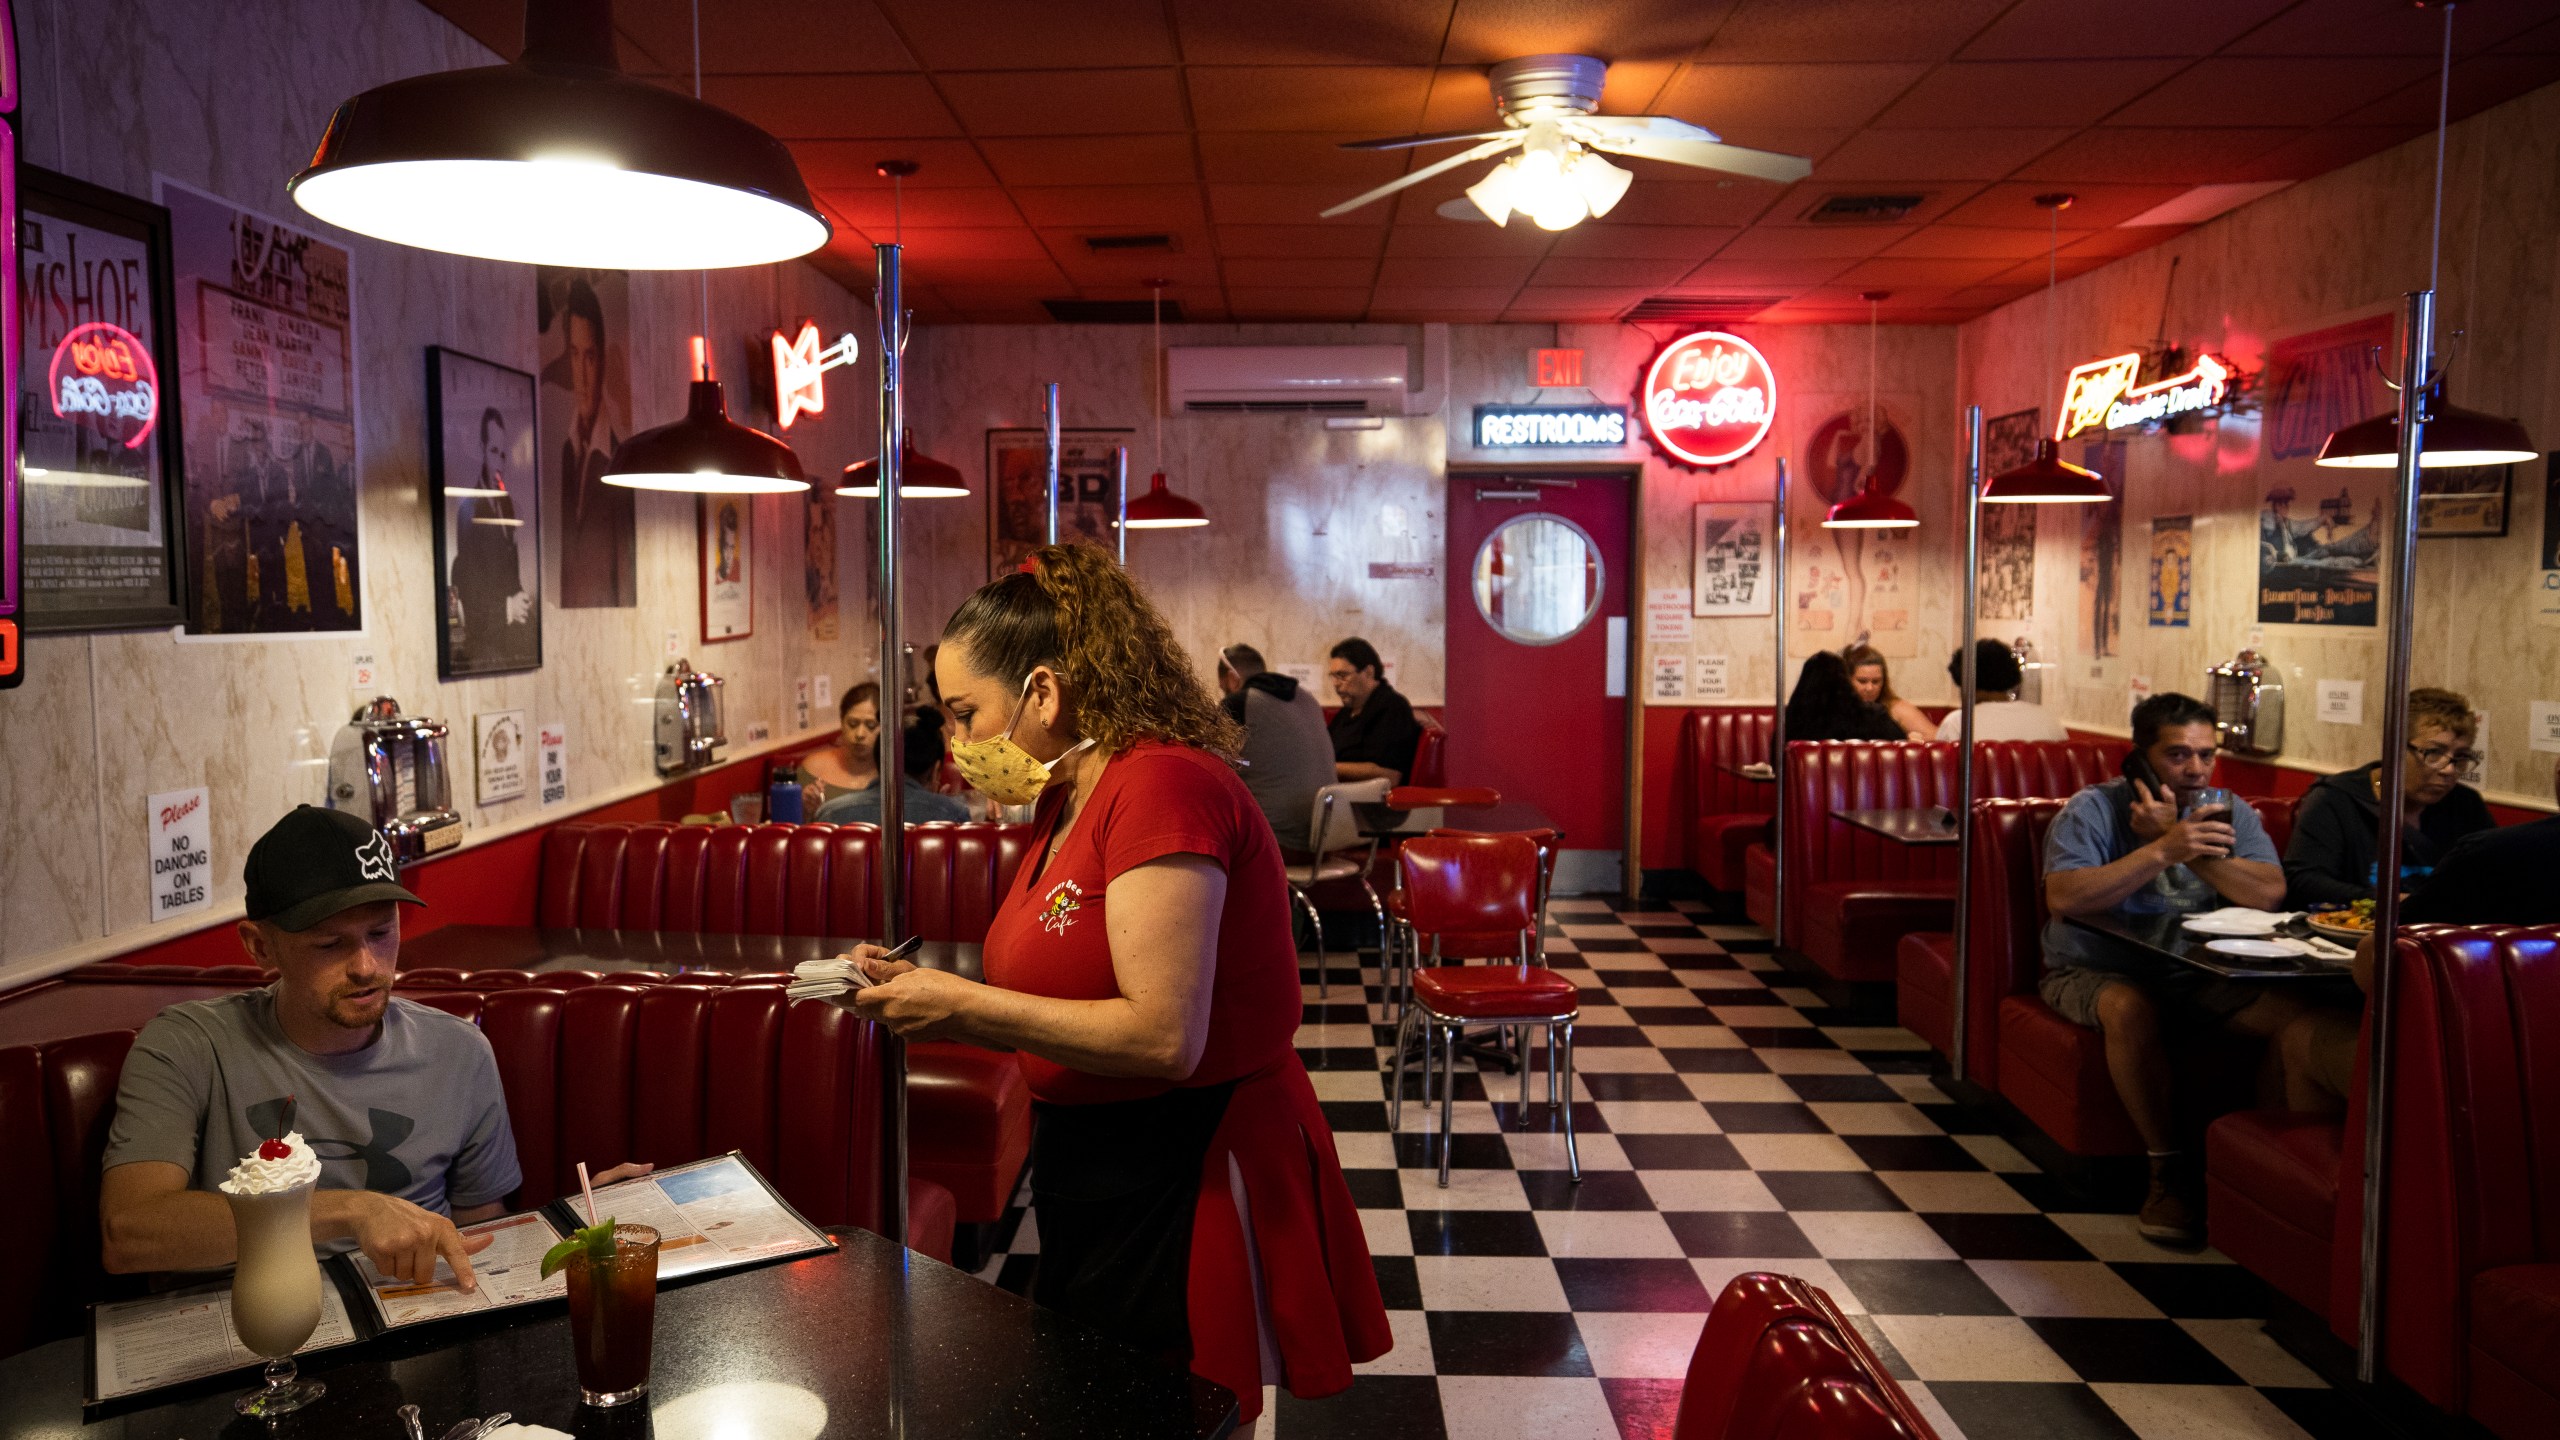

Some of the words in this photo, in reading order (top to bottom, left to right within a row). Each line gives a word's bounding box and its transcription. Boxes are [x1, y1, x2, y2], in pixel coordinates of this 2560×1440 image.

[277, 315, 321, 341] SINATRA
[275, 333, 313, 355] MARTIN
[1536, 348, 1584, 387] EXIT
[1672, 344, 1750, 391] Enjoy
[1651, 386, 1768, 430] Coca-Cola
[2271, 340, 2376, 461] GIANT
[1481, 412, 1625, 446] RESTROOMS
[160, 795, 200, 832] Please
[171, 835, 190, 852] NO
[155, 849, 207, 875] DANCING
[173, 871, 191, 889] ON
[160, 885, 205, 910] TABLES
[1045, 914, 1079, 937] Cafe
